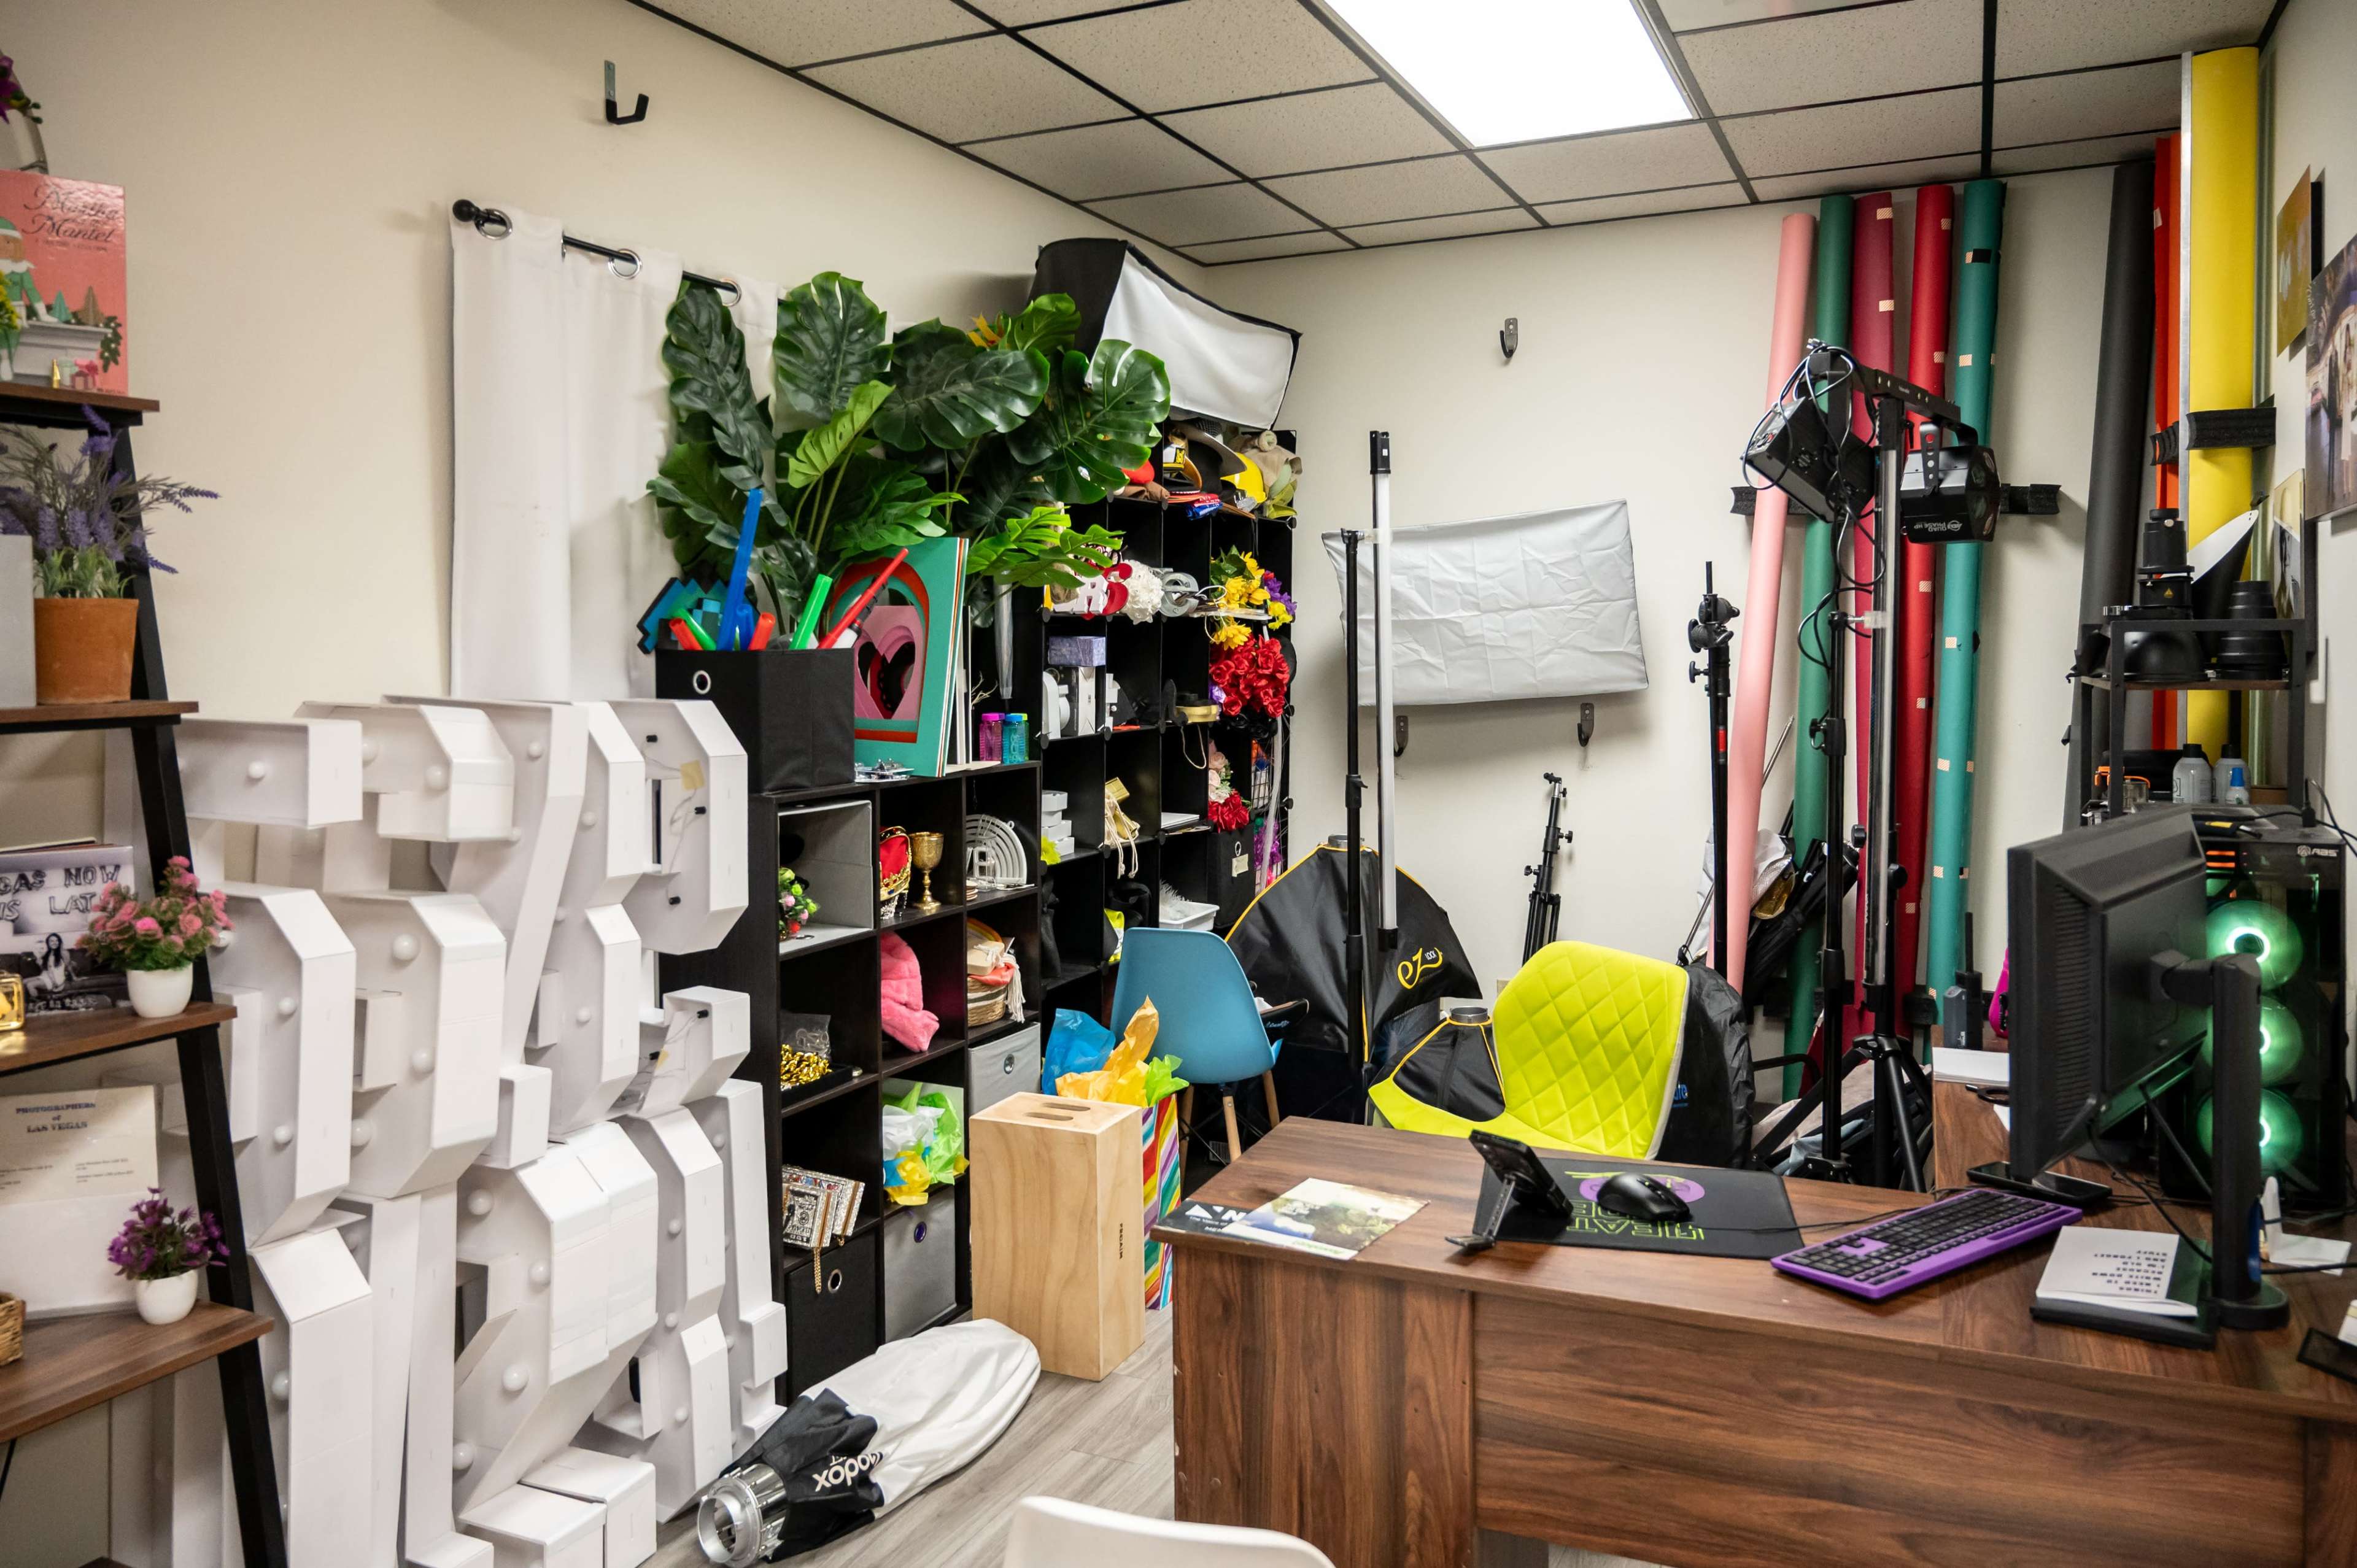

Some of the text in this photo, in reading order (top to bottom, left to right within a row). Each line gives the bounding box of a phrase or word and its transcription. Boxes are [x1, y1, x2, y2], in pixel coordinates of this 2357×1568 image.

[22, 214, 115, 242] Mantel
[64, 864, 121, 887] NOW
[48, 892, 96, 915] LAT
